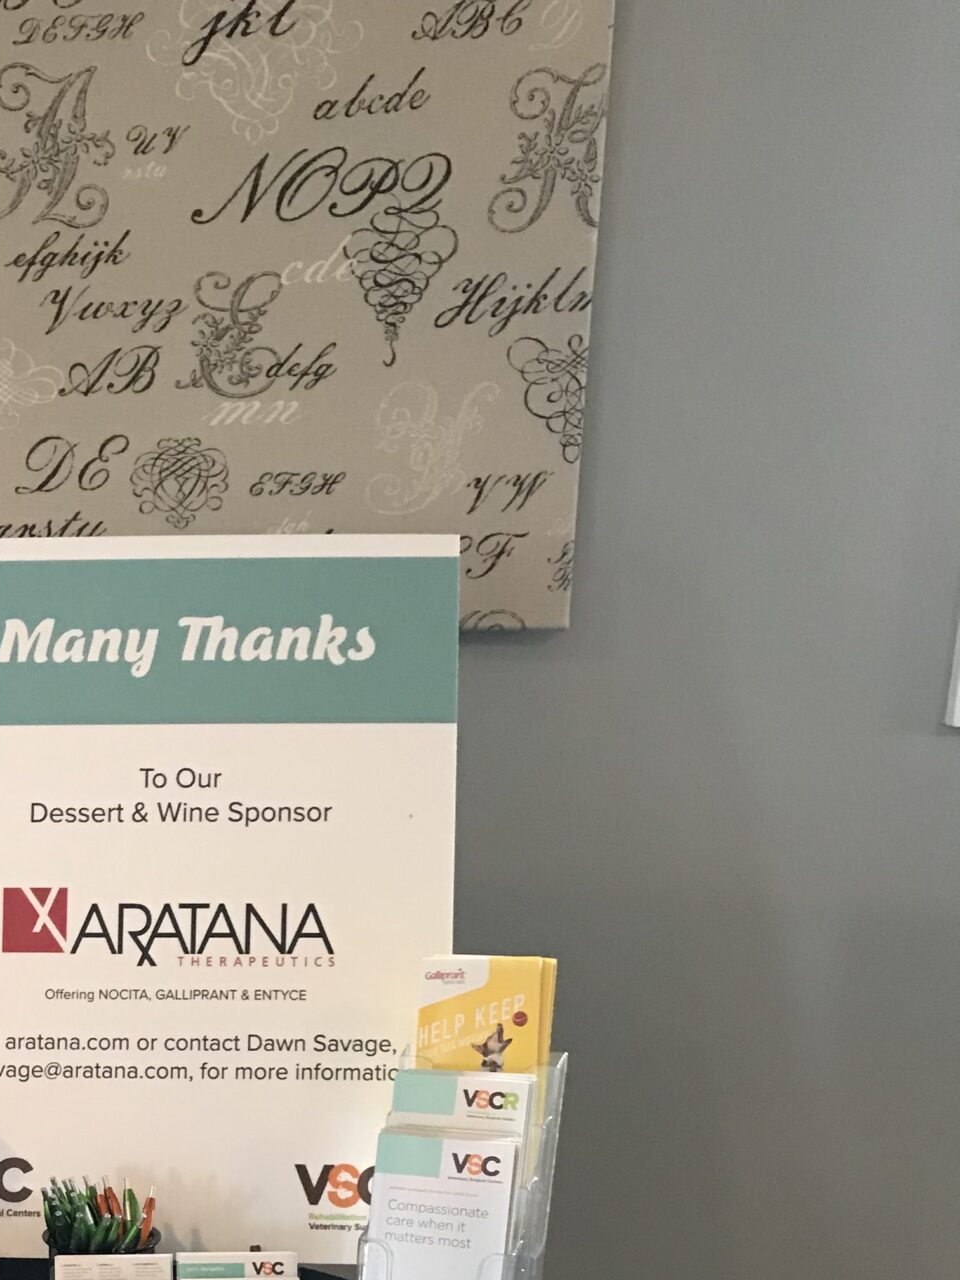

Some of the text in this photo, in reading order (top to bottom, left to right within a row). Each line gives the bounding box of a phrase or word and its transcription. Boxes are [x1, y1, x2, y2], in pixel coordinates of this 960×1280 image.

[313, 66, 430, 121] abcde
[177, 613, 376, 665] Thanks
[140, 767, 222, 789] To Our
[30, 801, 333, 827] Dessert & Wine Sponsor
[177, 955, 336, 968] THERAPEUTICS
[44, 988, 307, 1003] Offering NOCITA, GALLIPRANT & ENTYCE
[475, 993, 525, 1029] KEEP
[419, 1013, 465, 1047] HELP
[5, 1033, 130, 1053] aratana.com
[136, 1037, 159, 1053] or
[163, 1034, 240, 1053] contact
[247, 1033, 306, 1053] Dawn
[313, 1034, 398, 1057] Savage,
[200, 1061, 229, 1081] for
[235, 1066, 288, 1082] more
[463, 1089, 520, 1110] VSCR
[452, 1153, 501, 1176] VSC
[6, 1209, 41, 1218] Centers
[387, 1199, 489, 1219] Compassionate
[308, 1222, 353, 1232] Veterinary
[386, 1217, 465, 1232] care when it
[384, 1231, 471, 1249] matters most
[252, 1261, 284, 1276] VSC
